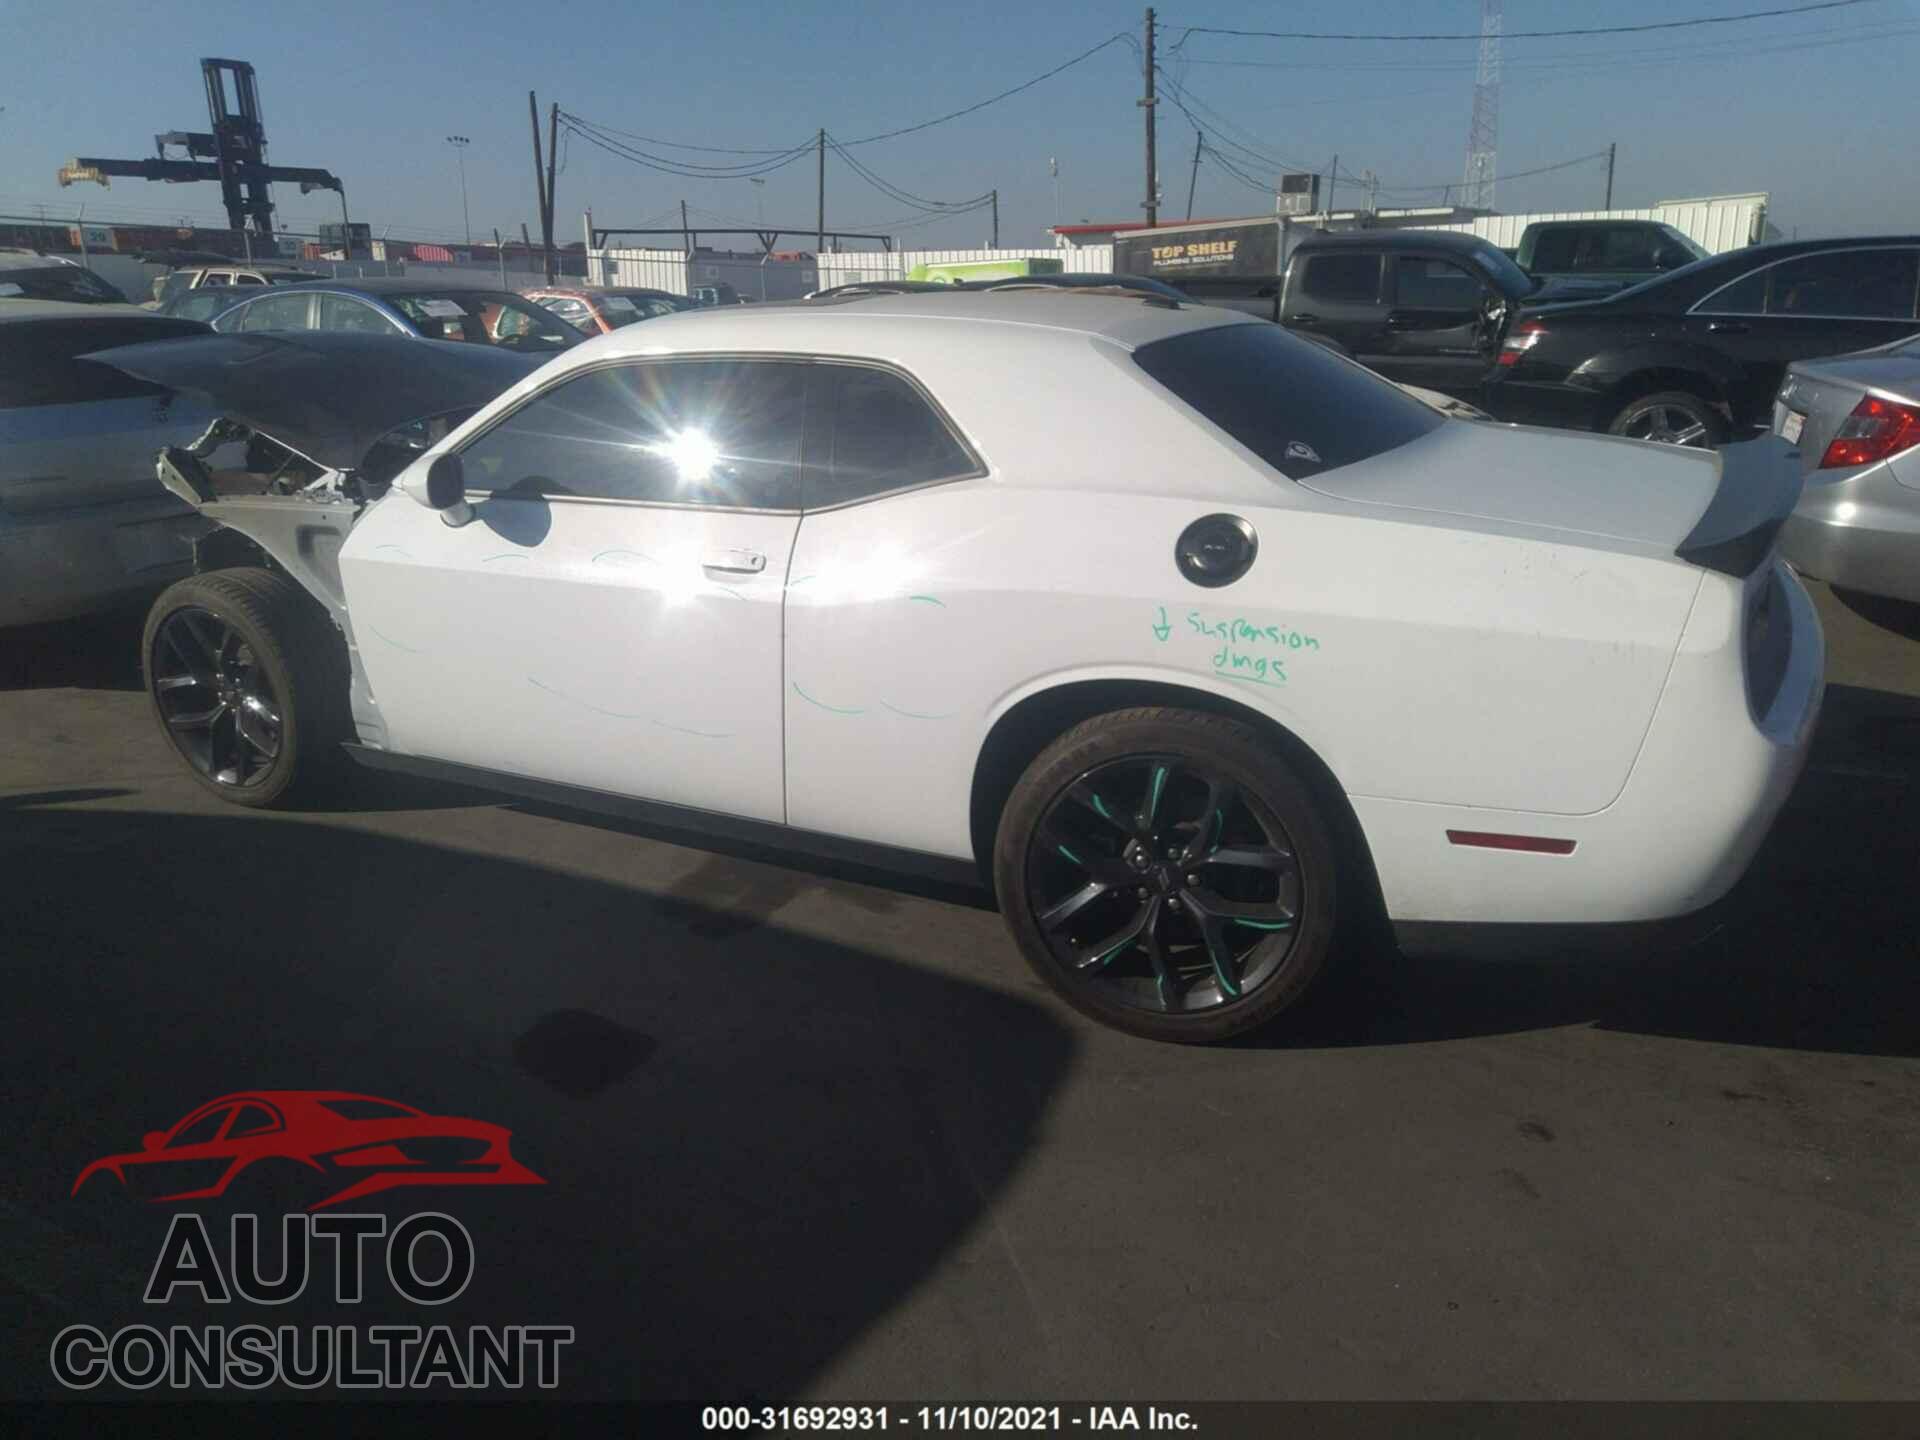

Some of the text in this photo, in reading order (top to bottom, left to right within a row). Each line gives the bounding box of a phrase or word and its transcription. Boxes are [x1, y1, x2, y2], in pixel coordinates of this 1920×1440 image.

[1152, 241, 1238, 259] TOP SHELF
[1213, 645, 1287, 680] dmgs
